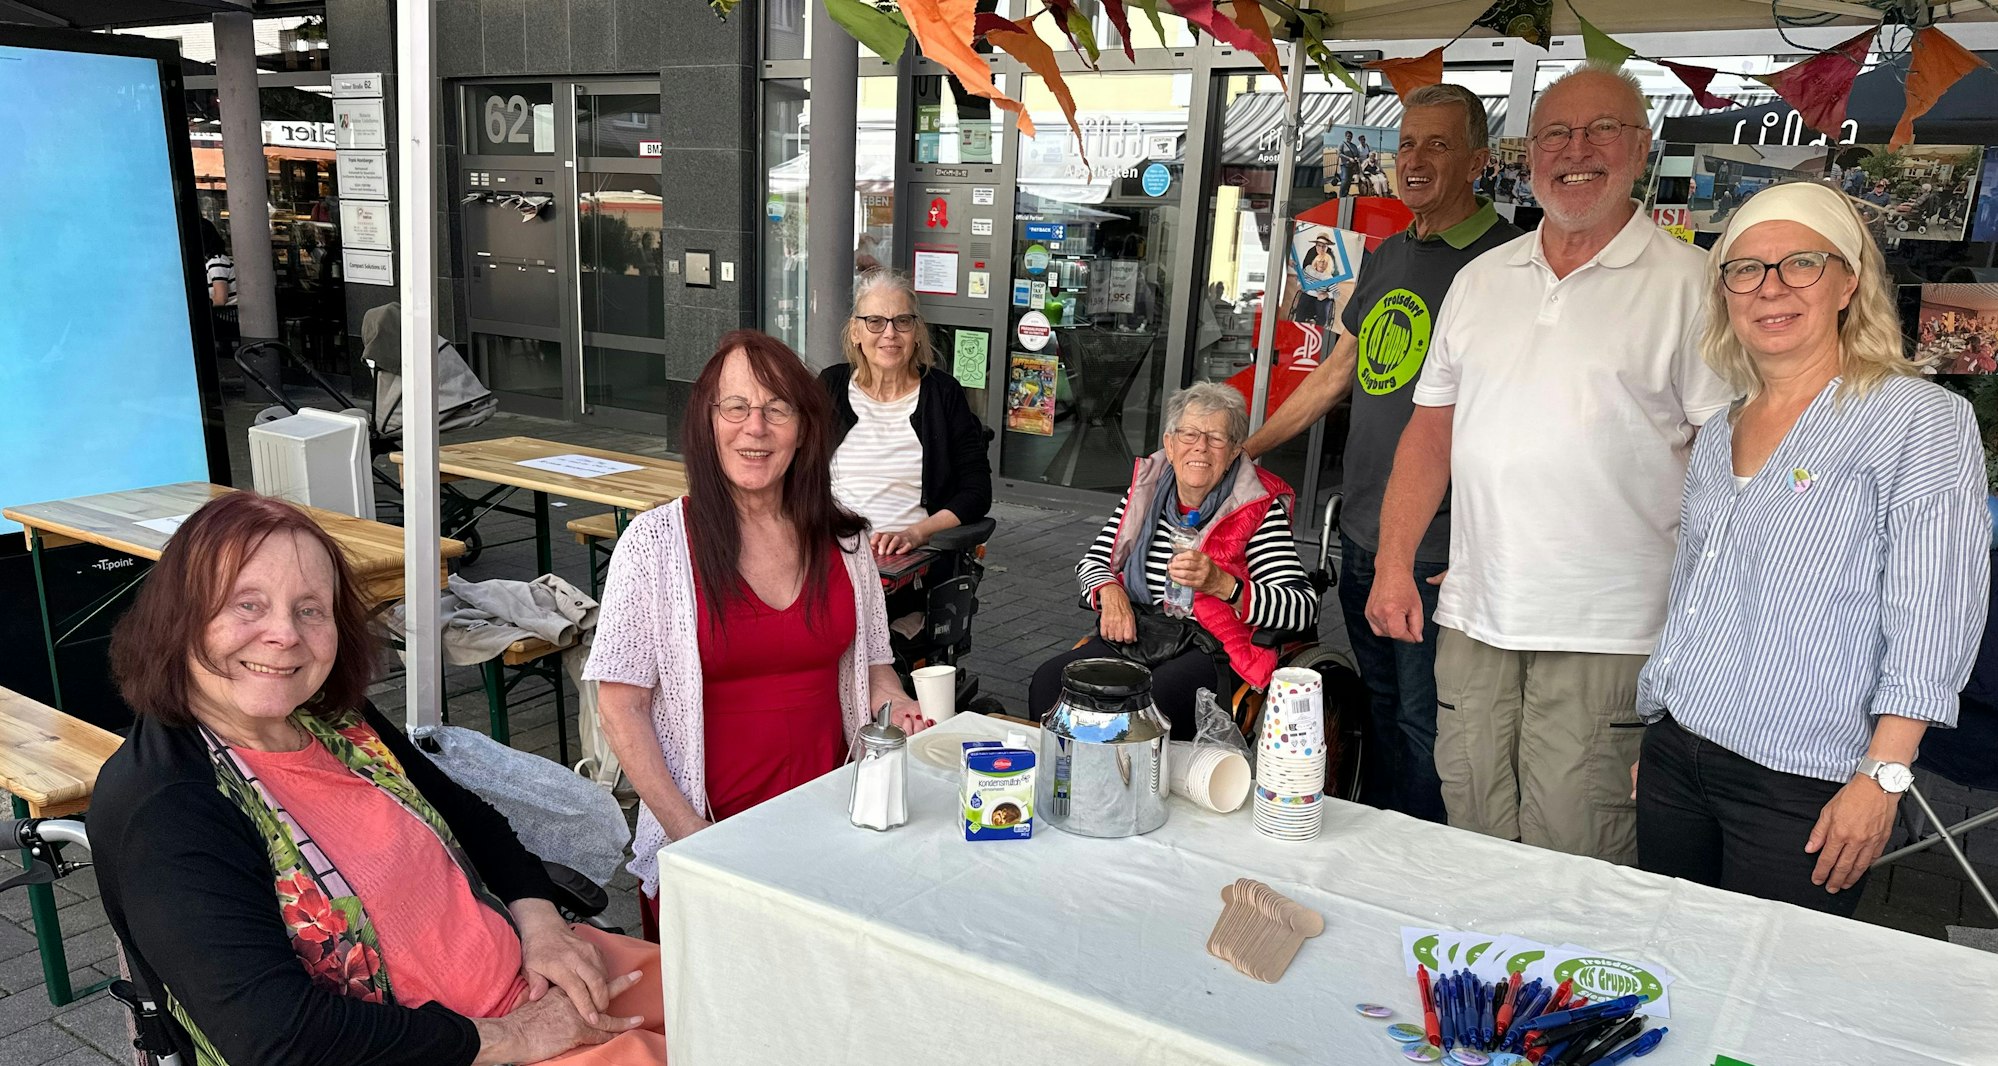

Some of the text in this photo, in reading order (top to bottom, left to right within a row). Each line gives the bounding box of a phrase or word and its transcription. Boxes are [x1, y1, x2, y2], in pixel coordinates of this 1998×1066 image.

[364, 80, 372, 89] 62
[485, 95, 529, 143] 62
[1063, 164, 1139, 181] Apotheken
[1579, 958, 1643, 974] Troisdorf
[1598, 967, 1639, 998] Gruppe
